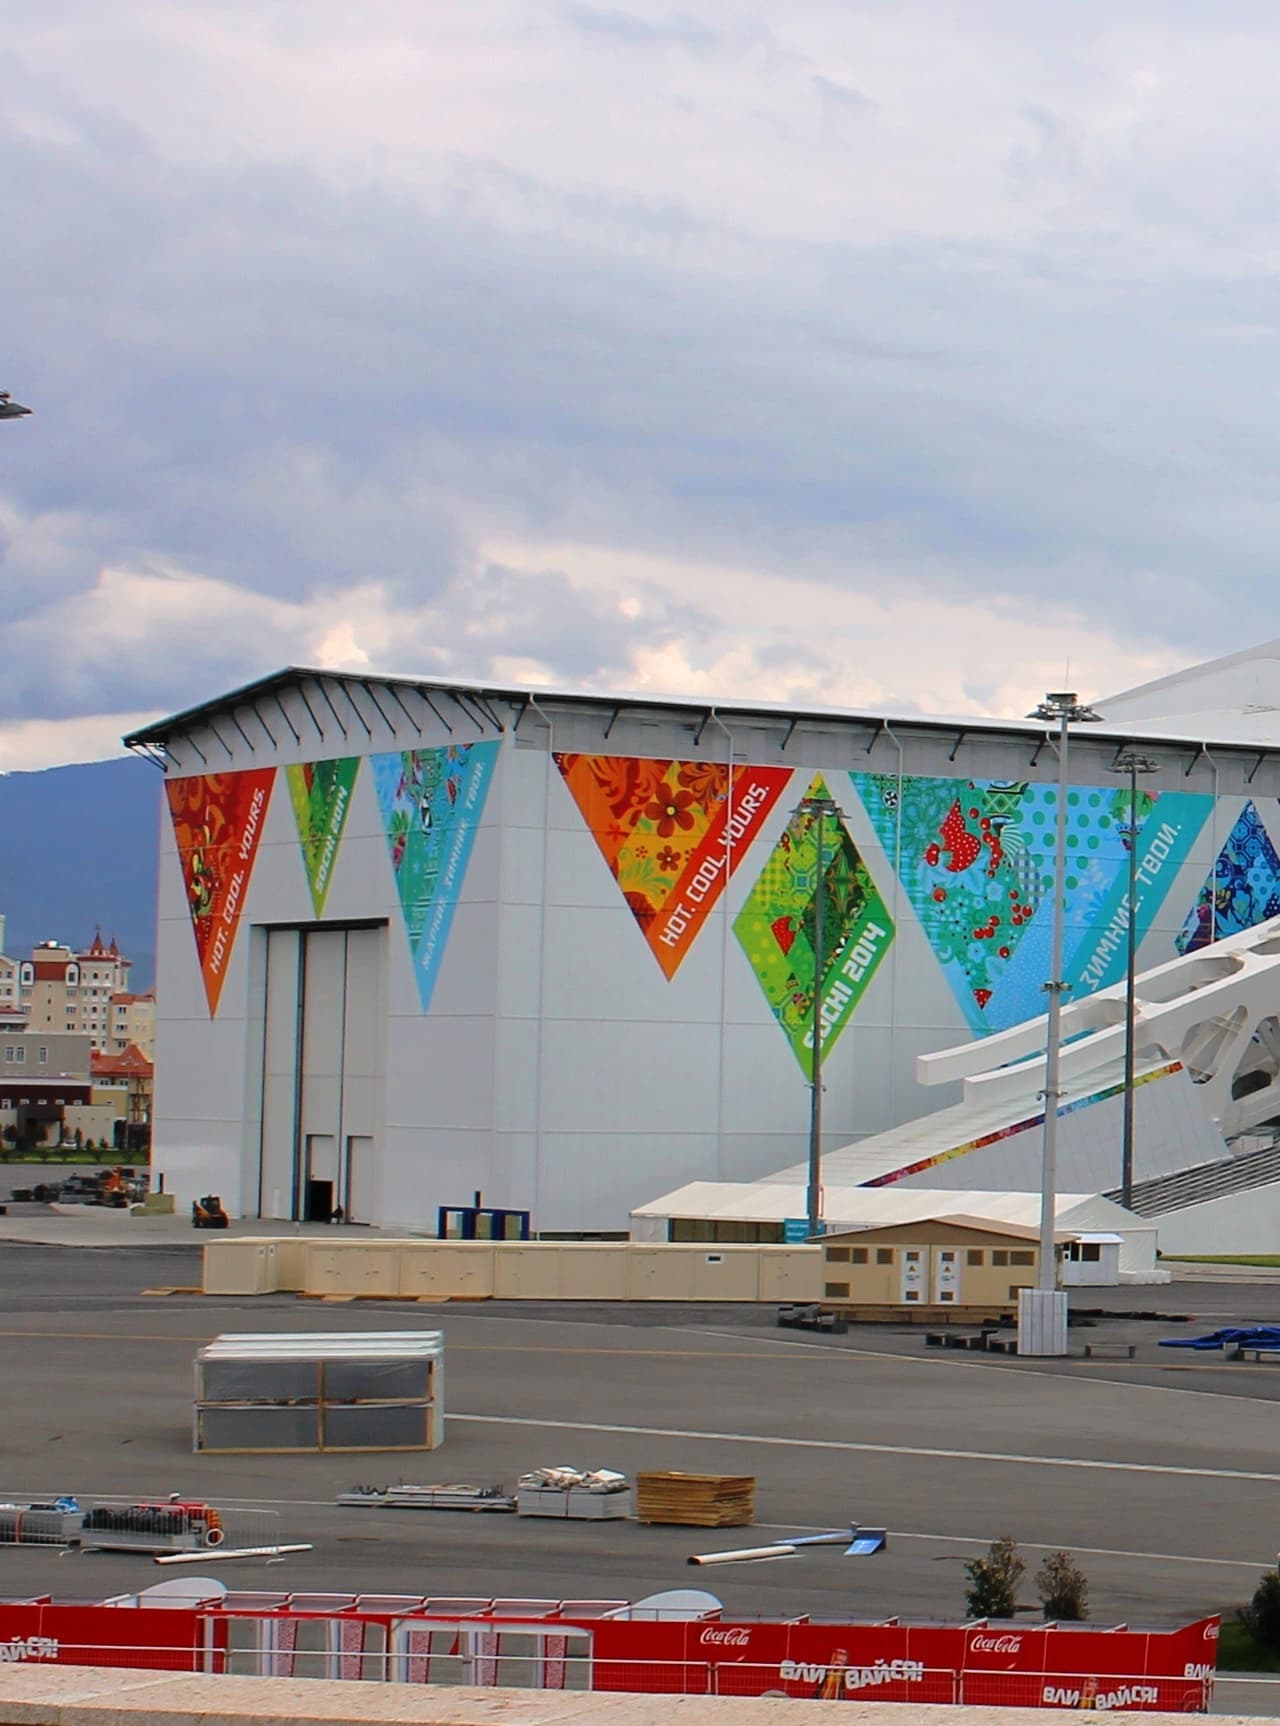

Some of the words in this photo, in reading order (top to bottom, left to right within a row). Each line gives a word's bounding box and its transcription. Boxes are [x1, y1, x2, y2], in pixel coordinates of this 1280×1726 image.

[209, 927, 228, 974] HOT.
[223, 869, 244, 924] COOL.
[238, 787, 265, 861] YOURS.
[659, 903, 696, 947] HOT.
[686, 854, 727, 903] COOL.
[717, 783, 770, 848] YOURS.
[1134, 823, 1182, 885] ТВОИ.
[842, 922, 887, 983] 2014
